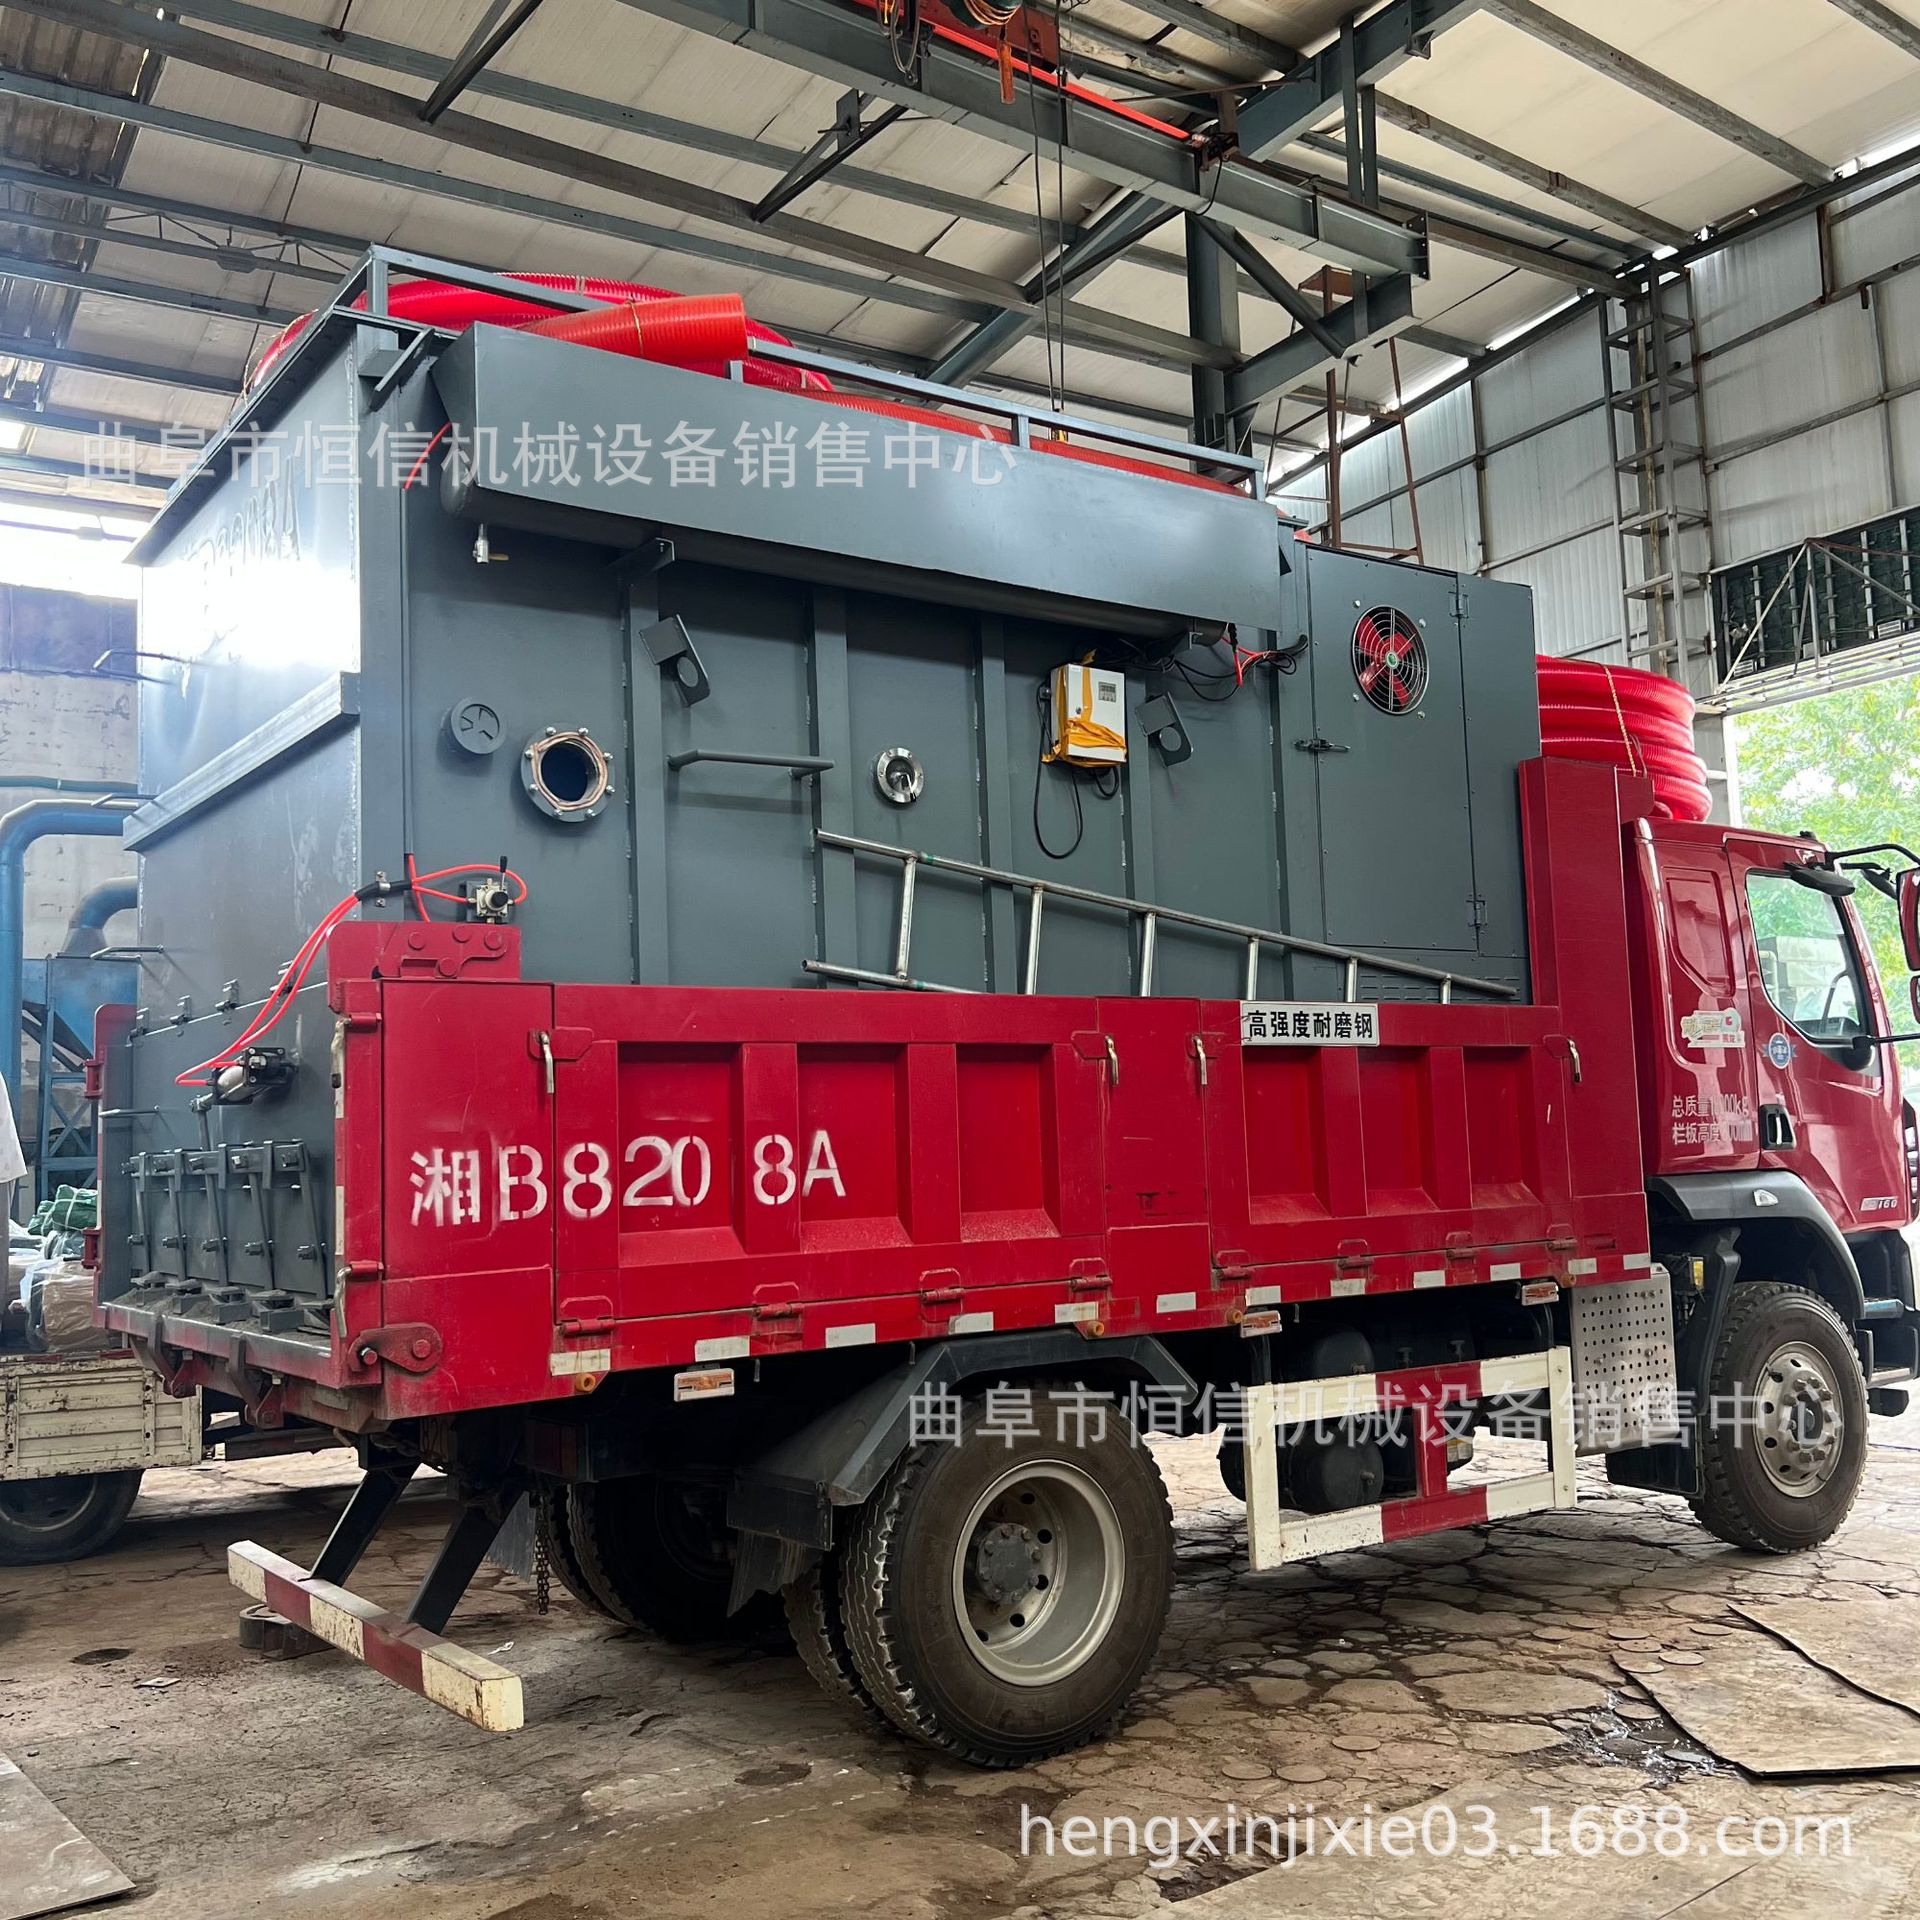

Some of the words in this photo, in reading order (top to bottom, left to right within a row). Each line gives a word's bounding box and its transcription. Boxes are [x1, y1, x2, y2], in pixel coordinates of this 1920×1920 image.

[1247, 1010, 1373, 1038] 高强度耐磨钢
